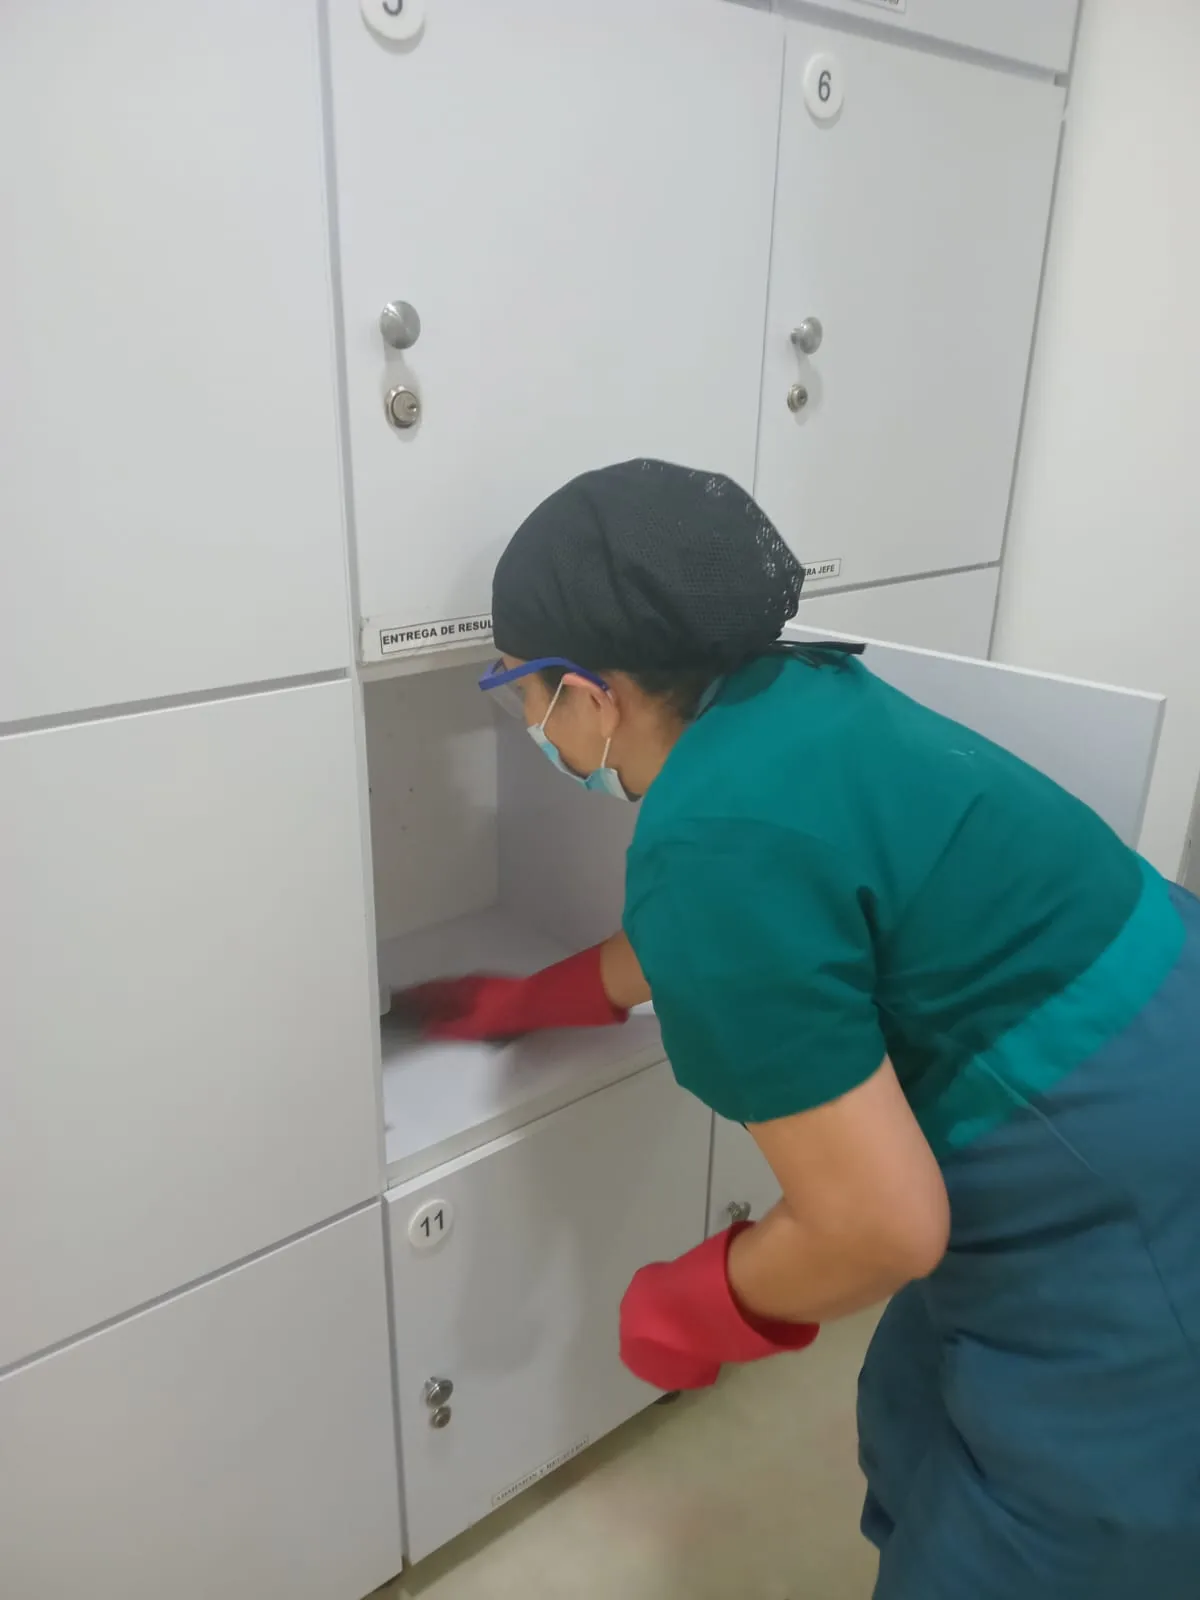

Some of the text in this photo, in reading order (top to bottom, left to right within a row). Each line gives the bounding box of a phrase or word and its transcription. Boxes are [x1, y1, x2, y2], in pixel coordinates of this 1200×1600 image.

[818, 70, 832, 103] 6
[804, 564, 835, 576] RA JEFE
[382, 619, 493, 645] ENTREGA DE RESUL
[420, 1208, 444, 1238] 11
